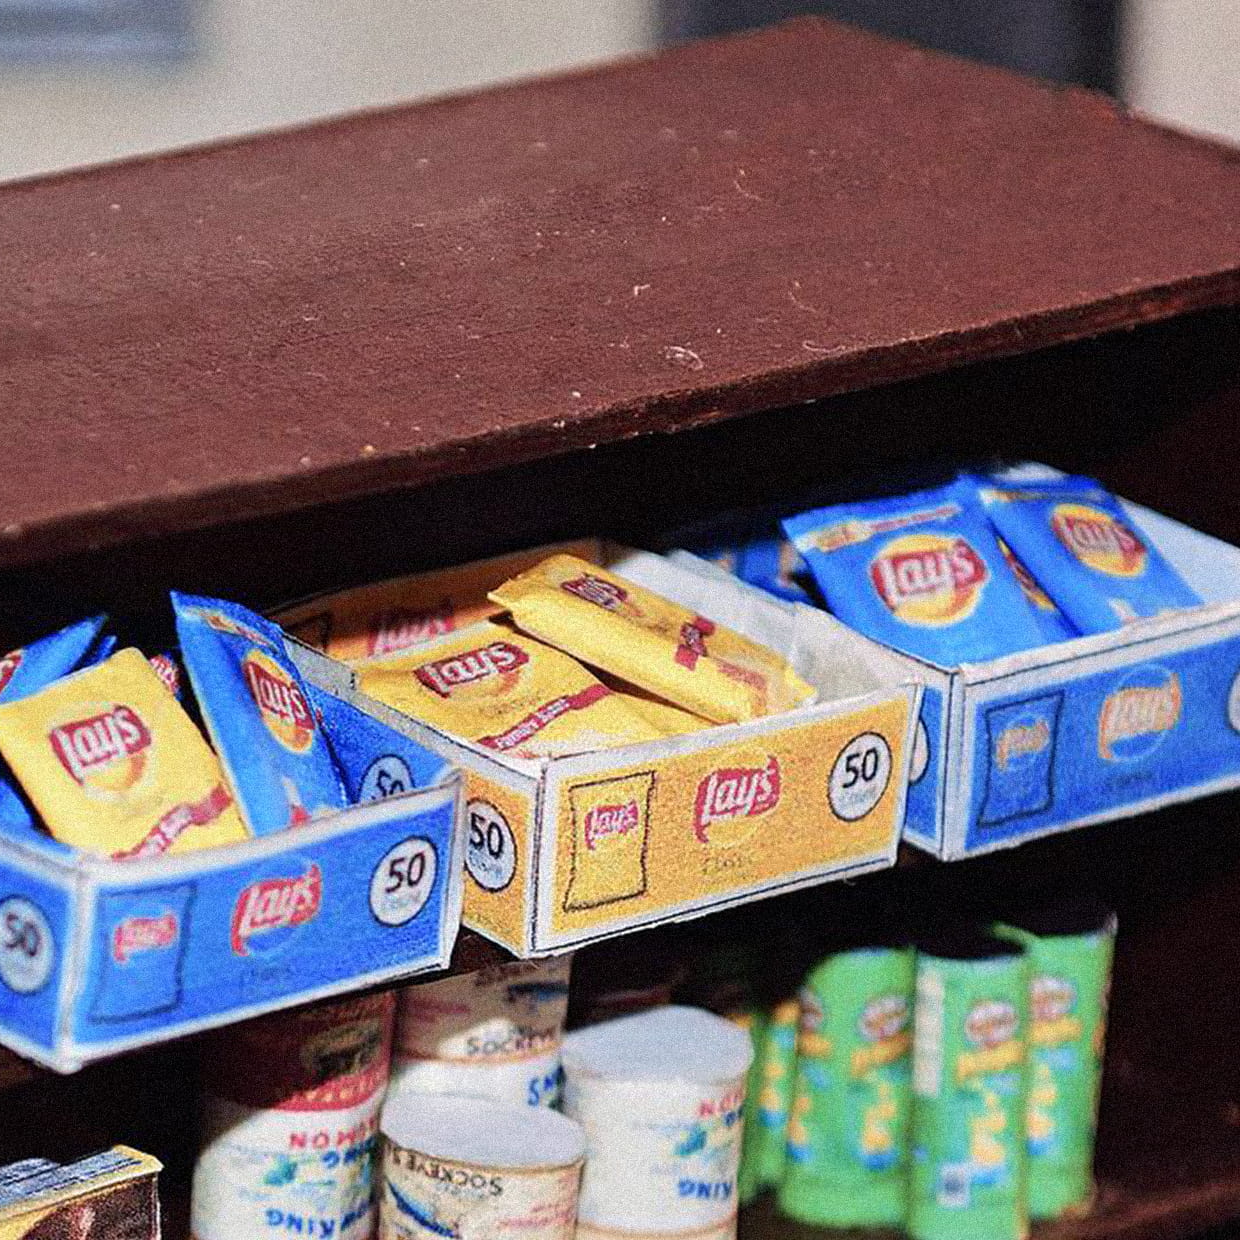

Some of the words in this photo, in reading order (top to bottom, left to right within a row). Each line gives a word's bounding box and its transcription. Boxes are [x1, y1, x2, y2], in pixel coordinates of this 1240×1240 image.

[842, 747, 879, 789] 50
[469, 812, 505, 860] 50
[385, 850, 427, 894] 50
[5, 911, 41, 957] 50
[263, 1206, 337, 1240] KING
